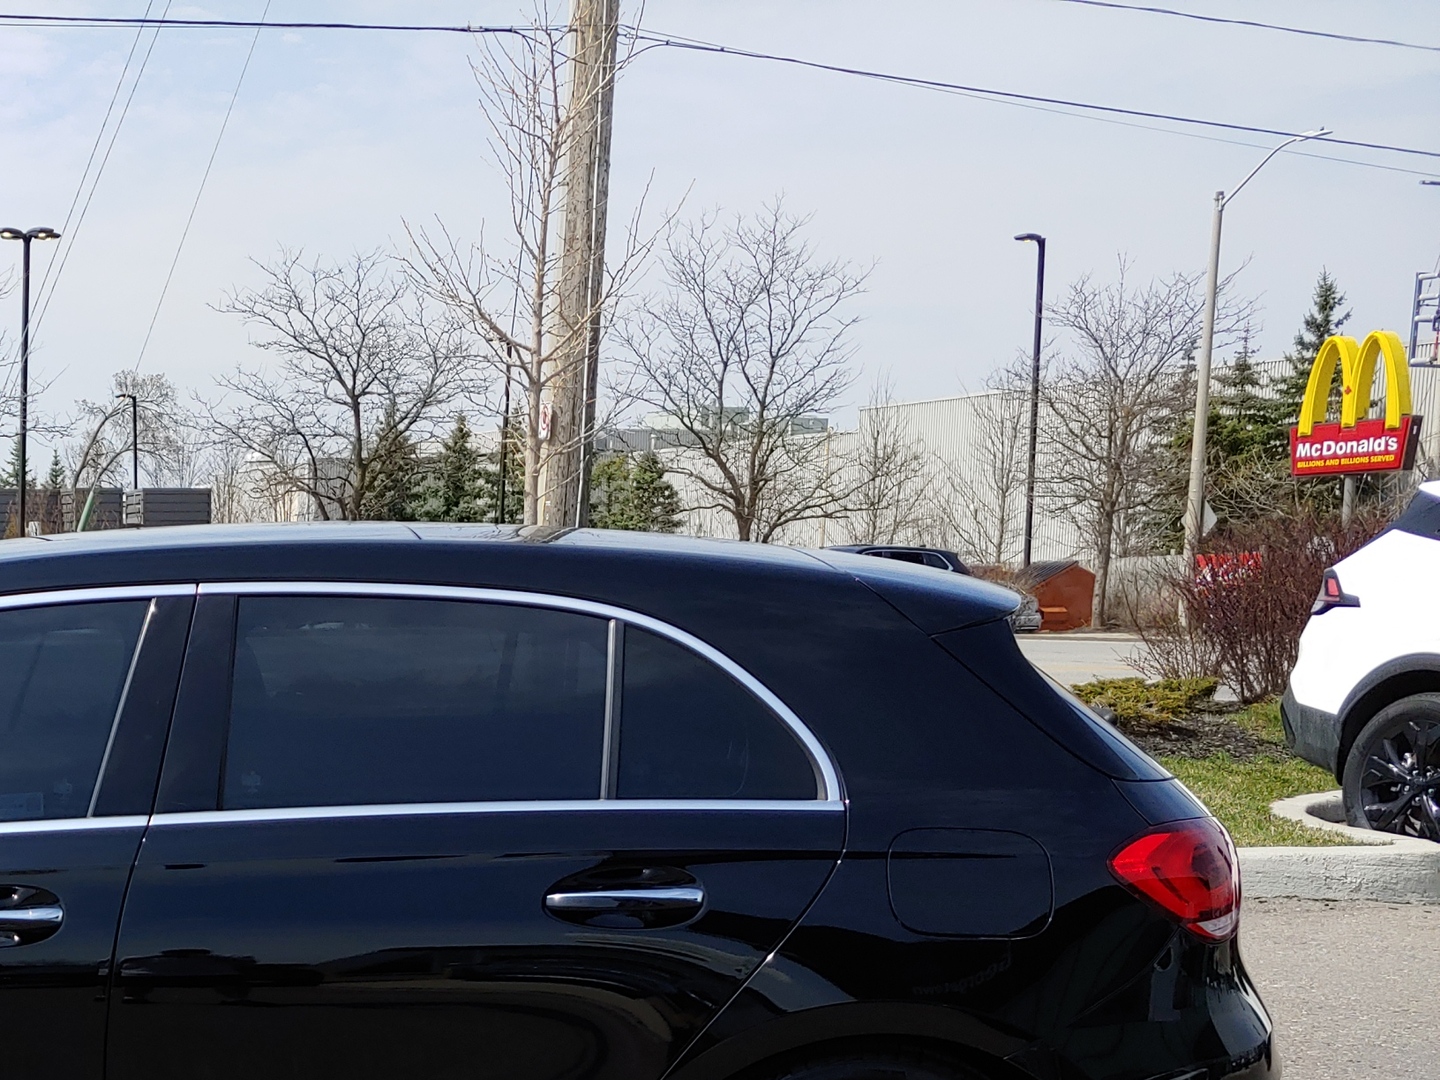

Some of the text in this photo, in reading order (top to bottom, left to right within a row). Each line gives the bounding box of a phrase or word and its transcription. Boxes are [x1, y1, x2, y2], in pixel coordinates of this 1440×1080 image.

[1296, 436, 1398, 458] McDonald's
[1297, 459, 1325, 468] BILLIONS
[1340, 456, 1369, 466] BILLIONS
[1370, 454, 1395, 463] SERVED
